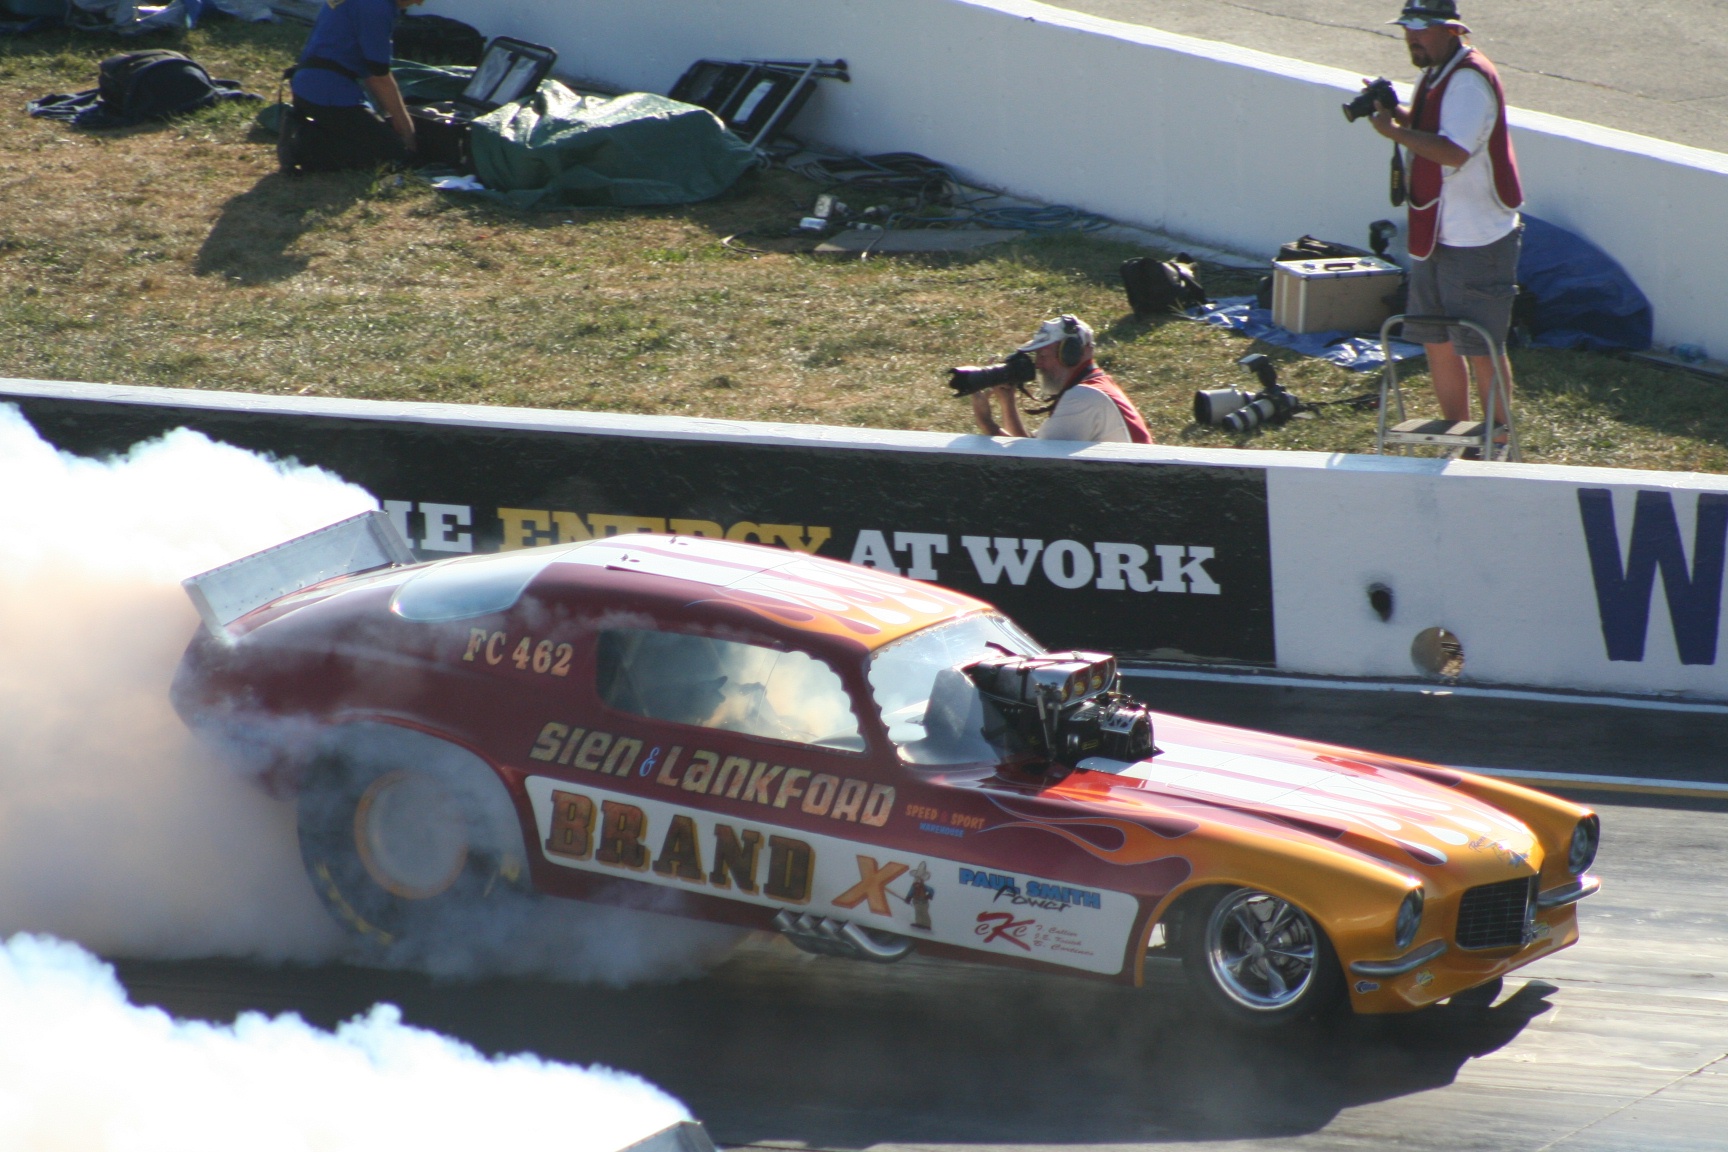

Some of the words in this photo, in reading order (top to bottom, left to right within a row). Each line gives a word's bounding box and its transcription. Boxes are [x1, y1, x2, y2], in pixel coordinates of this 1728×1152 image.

[850, 529, 949, 581] AT
[961, 535, 1221, 595] WORK
[1577, 487, 1728, 665] W
[462, 627, 507, 666] FC
[512, 637, 574, 677] 462
[639, 746, 662, 777] &
[905, 804, 938, 821] SPEED
[950, 812, 985, 830] SPORT
[545, 789, 816, 906] BRAND
[831, 855, 910, 917] X
[959, 867, 1021, 895] PAUL
[1026, 880, 1101, 910] SMITH
